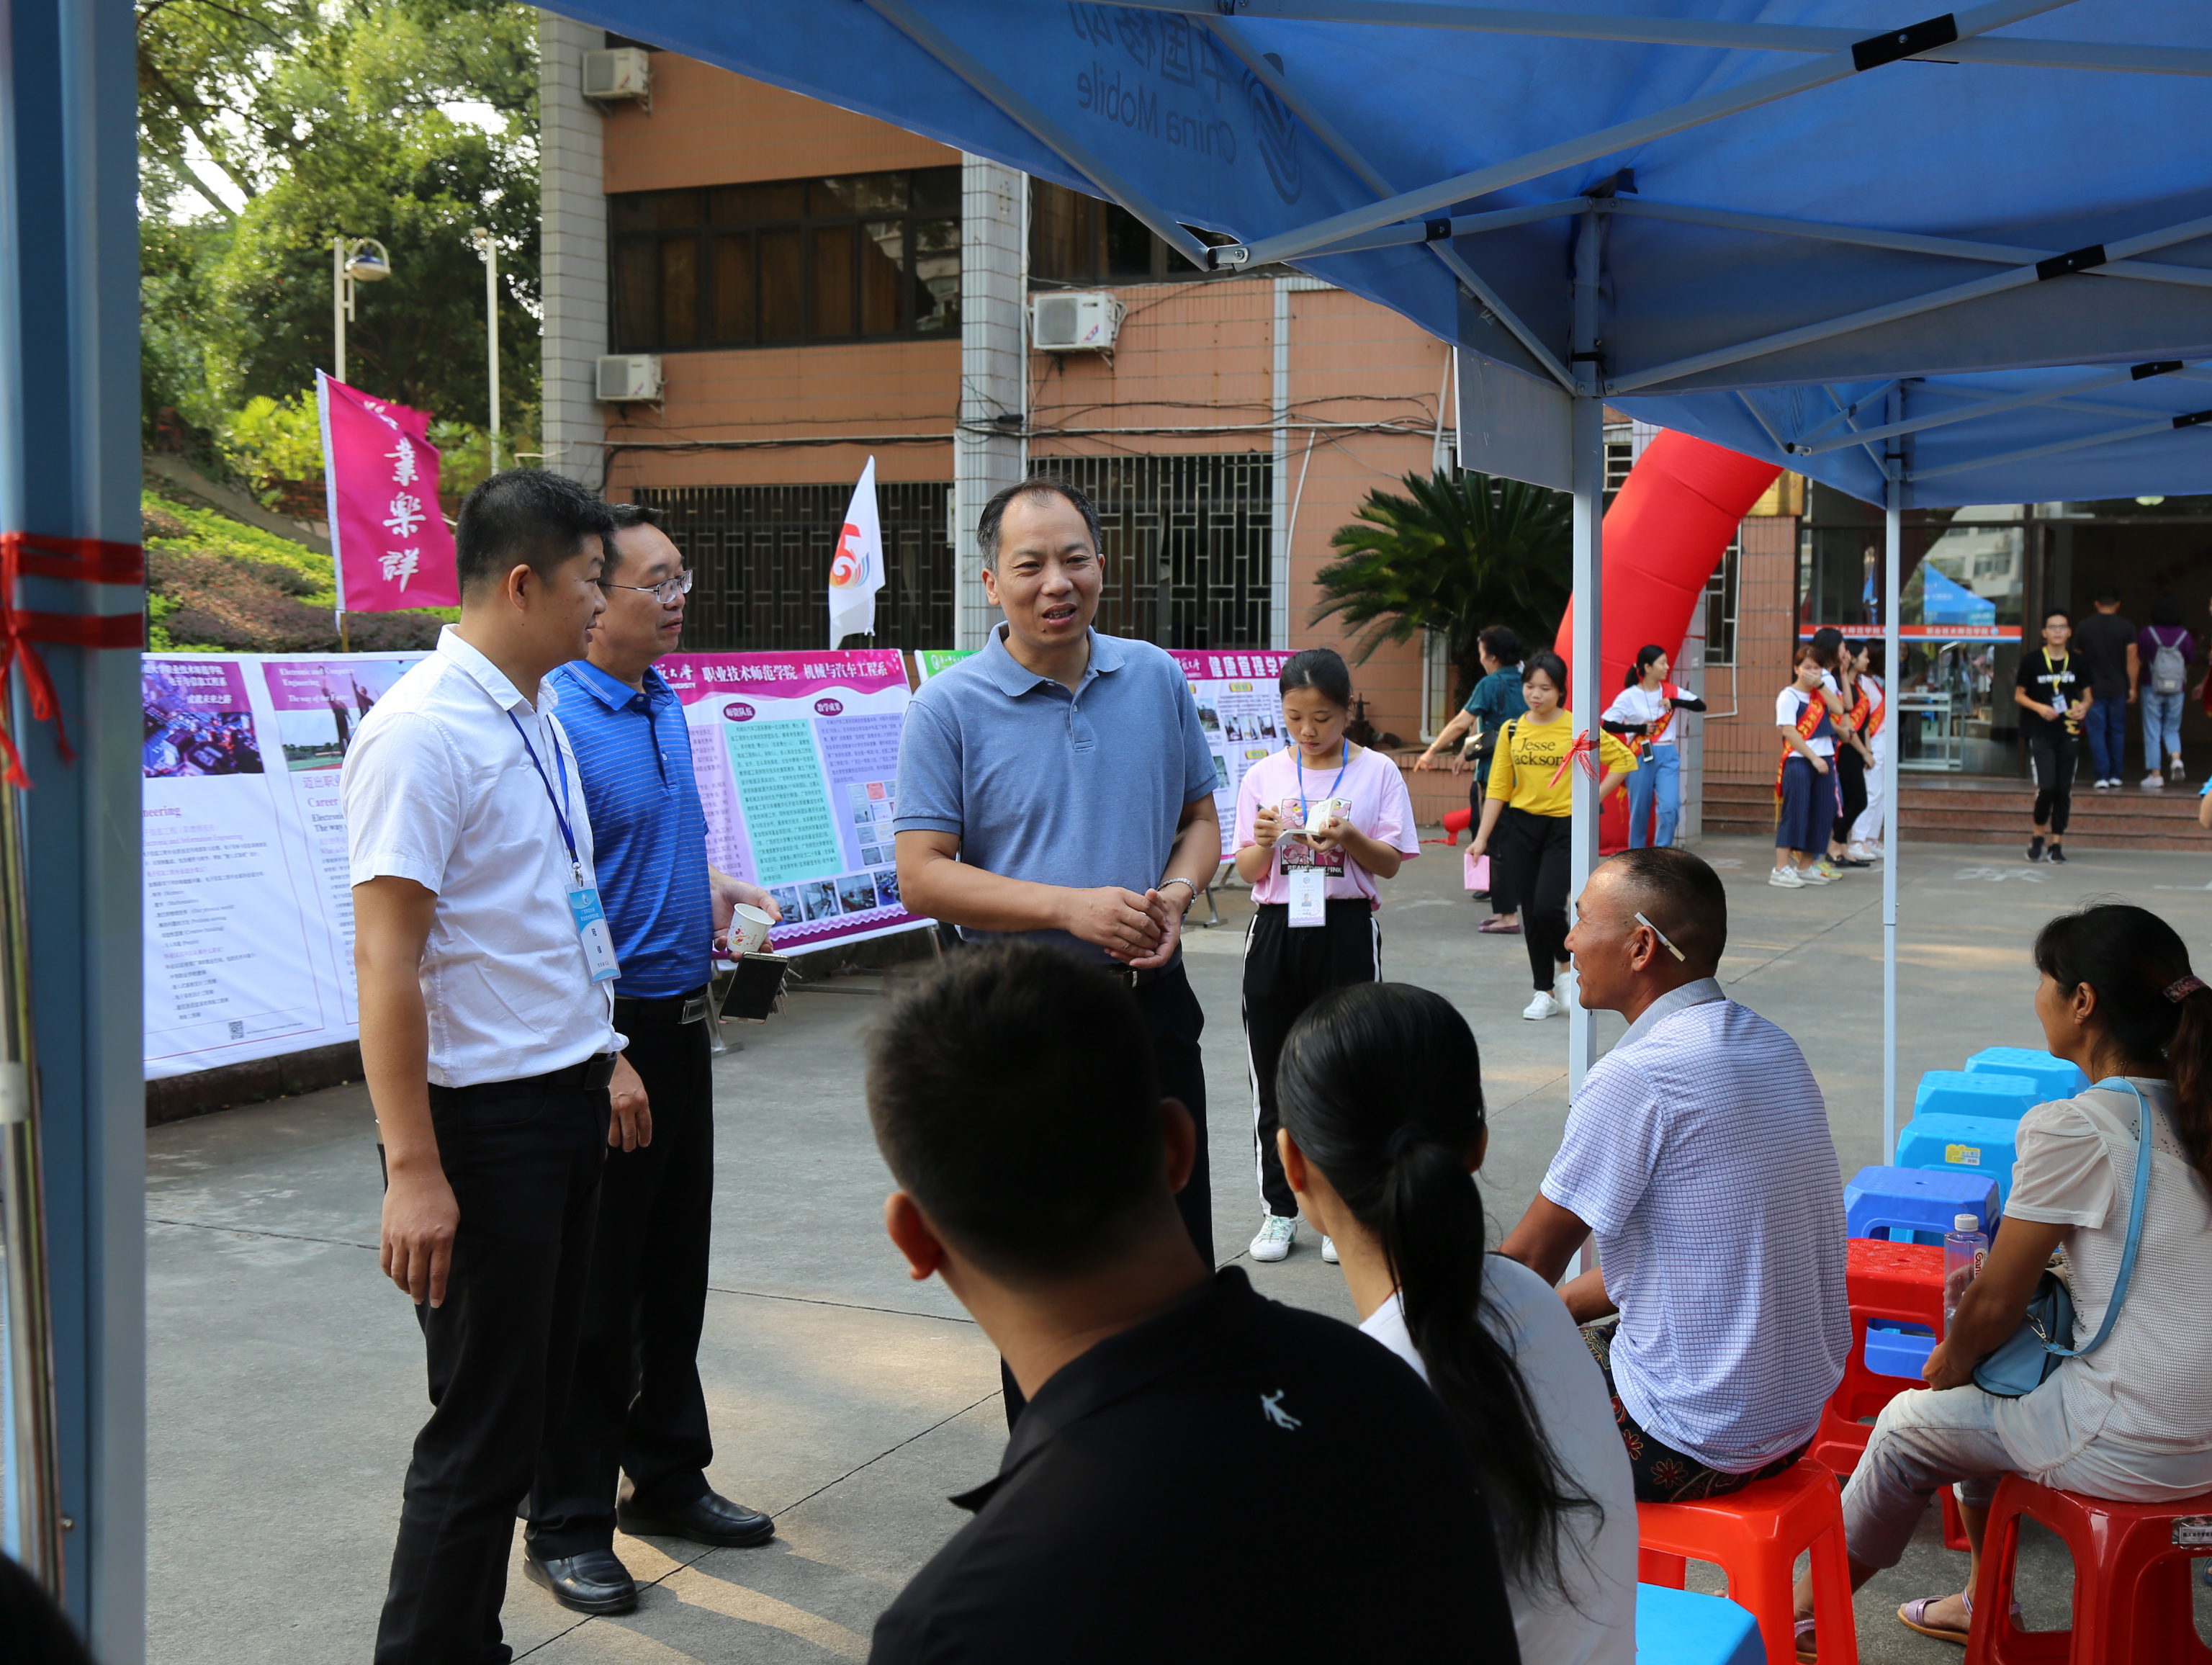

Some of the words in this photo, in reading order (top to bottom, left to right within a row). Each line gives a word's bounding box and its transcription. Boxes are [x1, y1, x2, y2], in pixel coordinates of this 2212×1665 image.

[701, 664, 798, 683] 职业技术师范学院
[803, 662, 889, 679] 机械与汽车工程系
[1518, 738, 1556, 753] Jesse
[307, 797, 338, 807] Career
